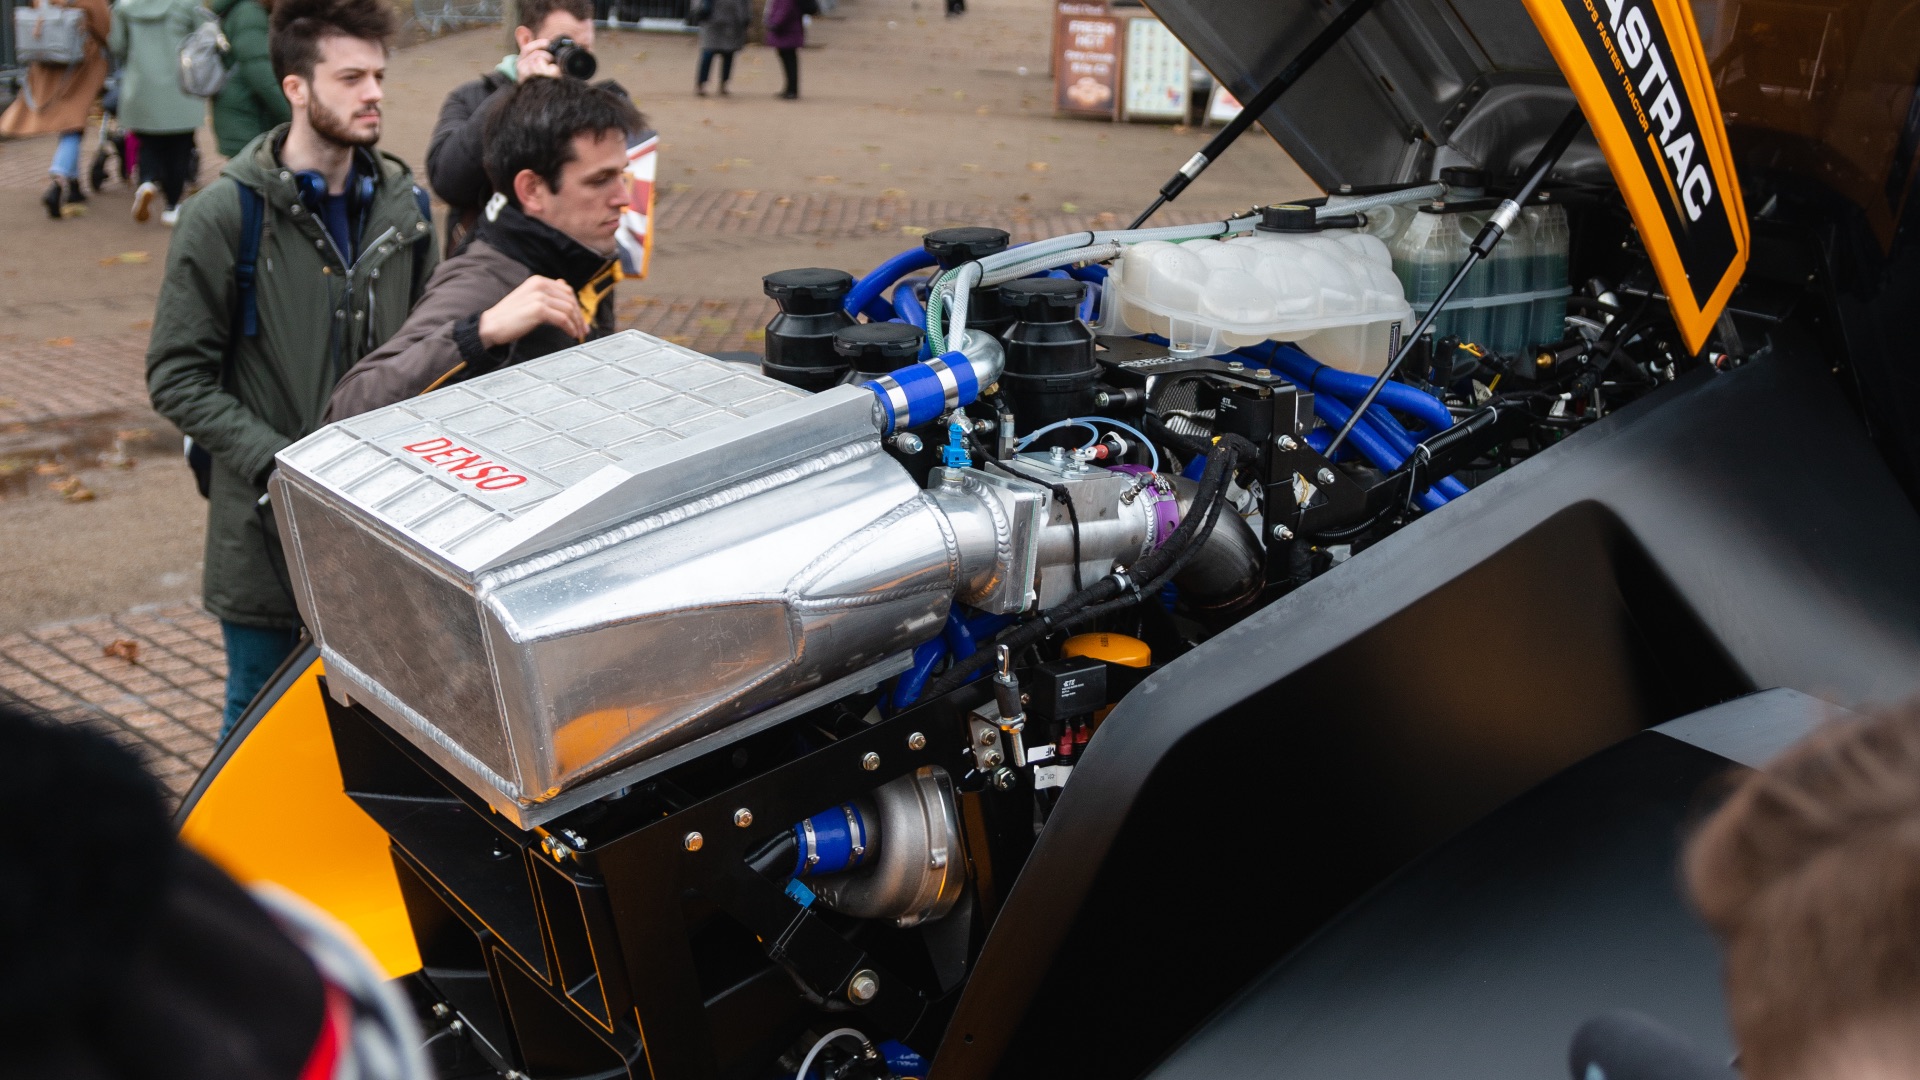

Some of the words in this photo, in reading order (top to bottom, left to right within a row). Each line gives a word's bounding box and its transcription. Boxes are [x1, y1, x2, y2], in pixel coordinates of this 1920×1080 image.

[1596, 21, 1625, 76] FASTEST
[1622, 75, 1650, 133] TRACTOR
[402, 437, 528, 491] DENSO
